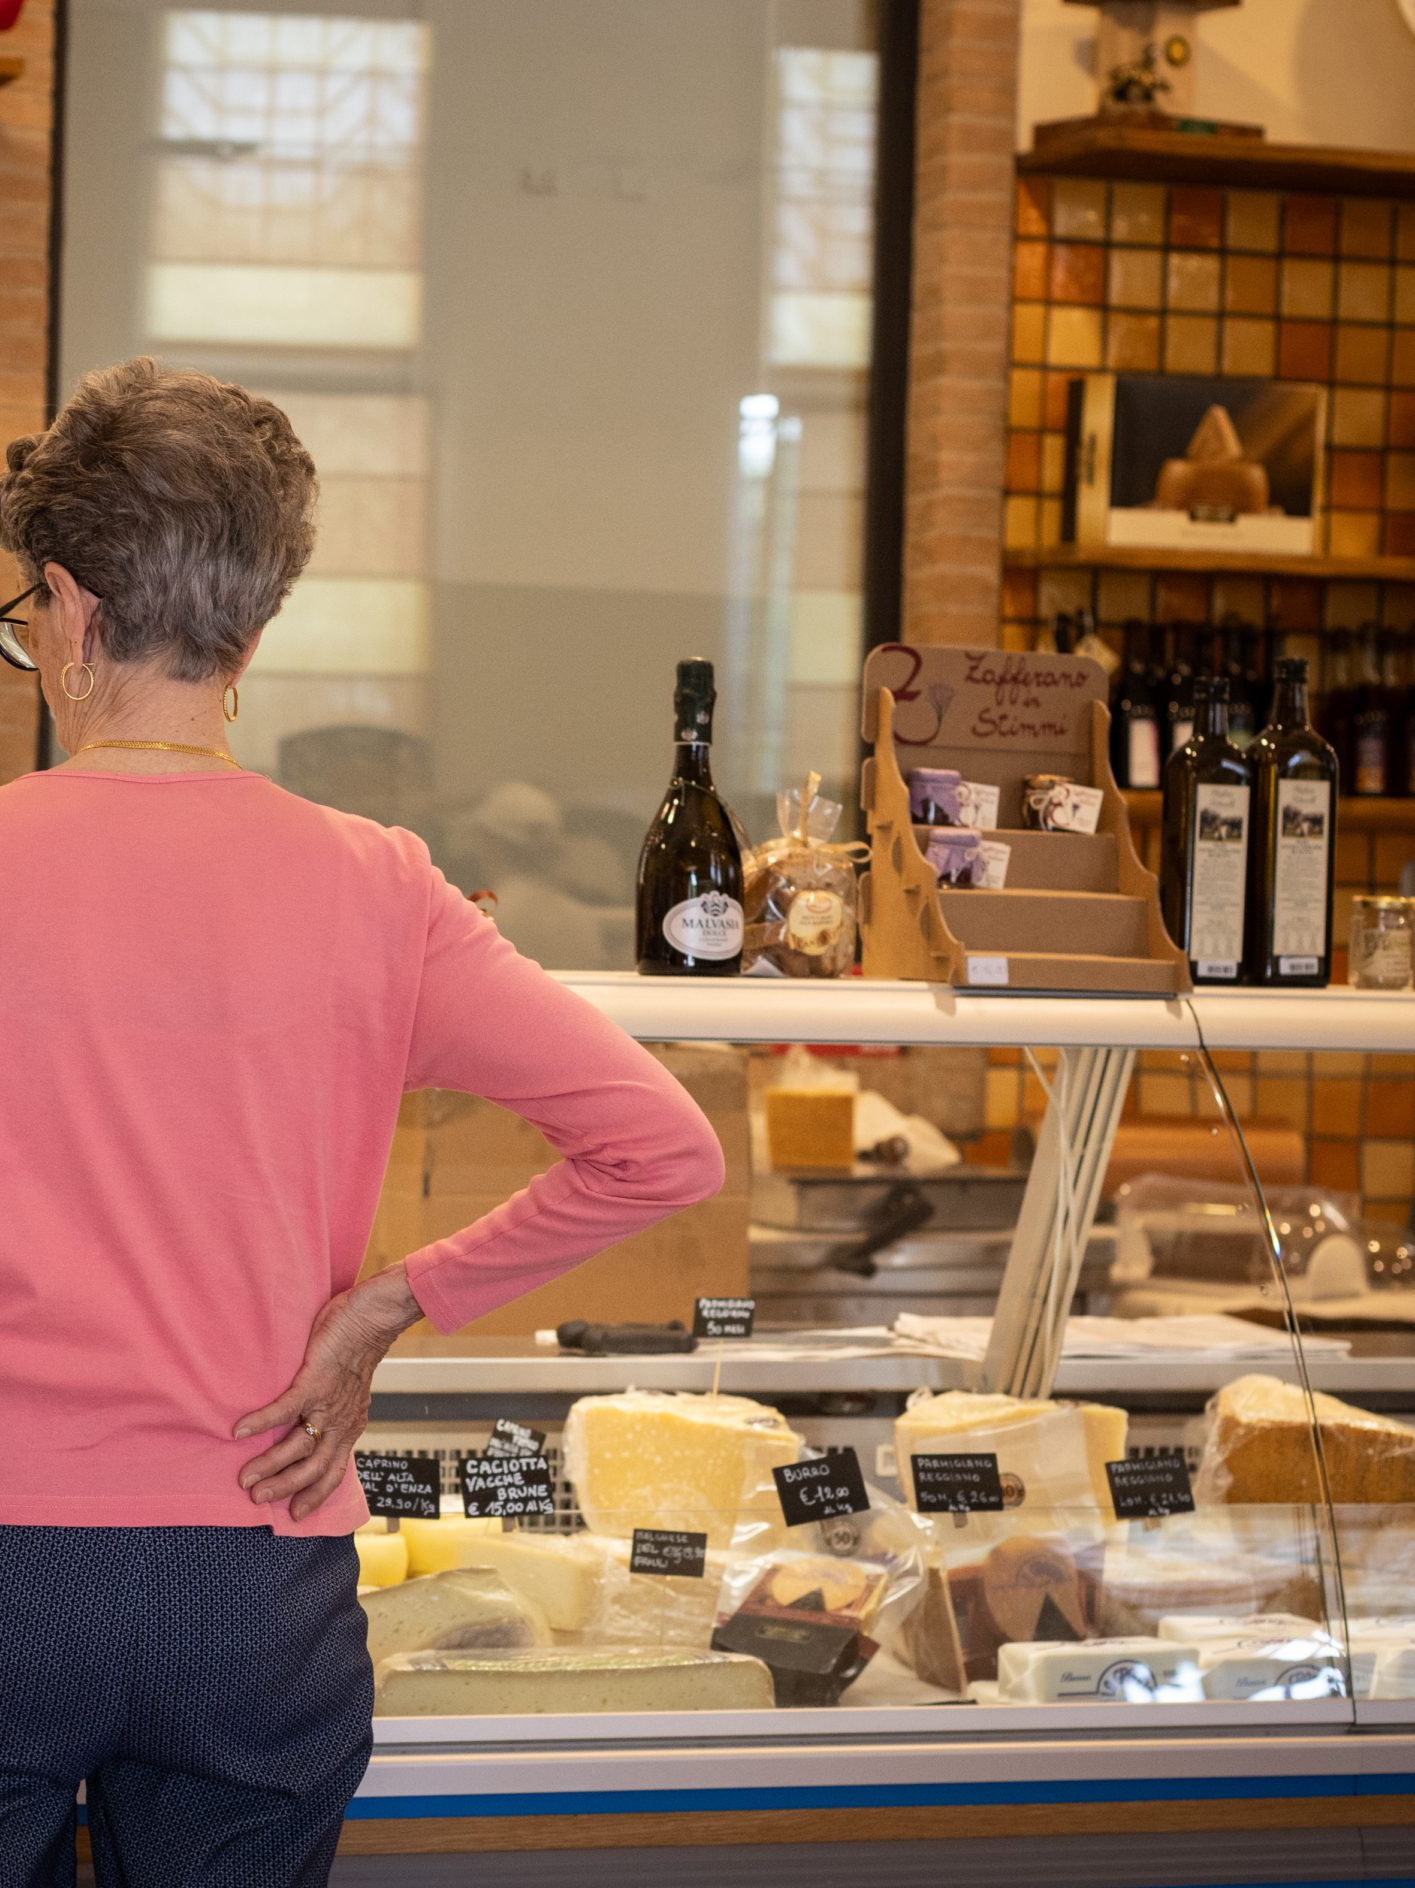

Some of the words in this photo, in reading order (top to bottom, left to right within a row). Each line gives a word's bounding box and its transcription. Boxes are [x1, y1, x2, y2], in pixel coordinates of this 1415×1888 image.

[965, 651, 1089, 706] Zafferano
[972, 708, 1067, 739] Stimmi
[356, 1458, 408, 1470] CAPRINO
[466, 1458, 548, 1474] CACIOTTA
[917, 1457, 993, 1469] PARMIGIANO
[1111, 1459, 1181, 1473] PARMIGIANO
[387, 1472, 414, 1483] ALTA
[783, 1464, 830, 1483] BURRO
[918, 1472, 981, 1483] REGGIANO
[466, 1472, 524, 1492] VACCHE
[497, 1484, 548, 1501] BRUNE
[799, 1487, 816, 1506] €
[468, 1502, 480, 1516] €
